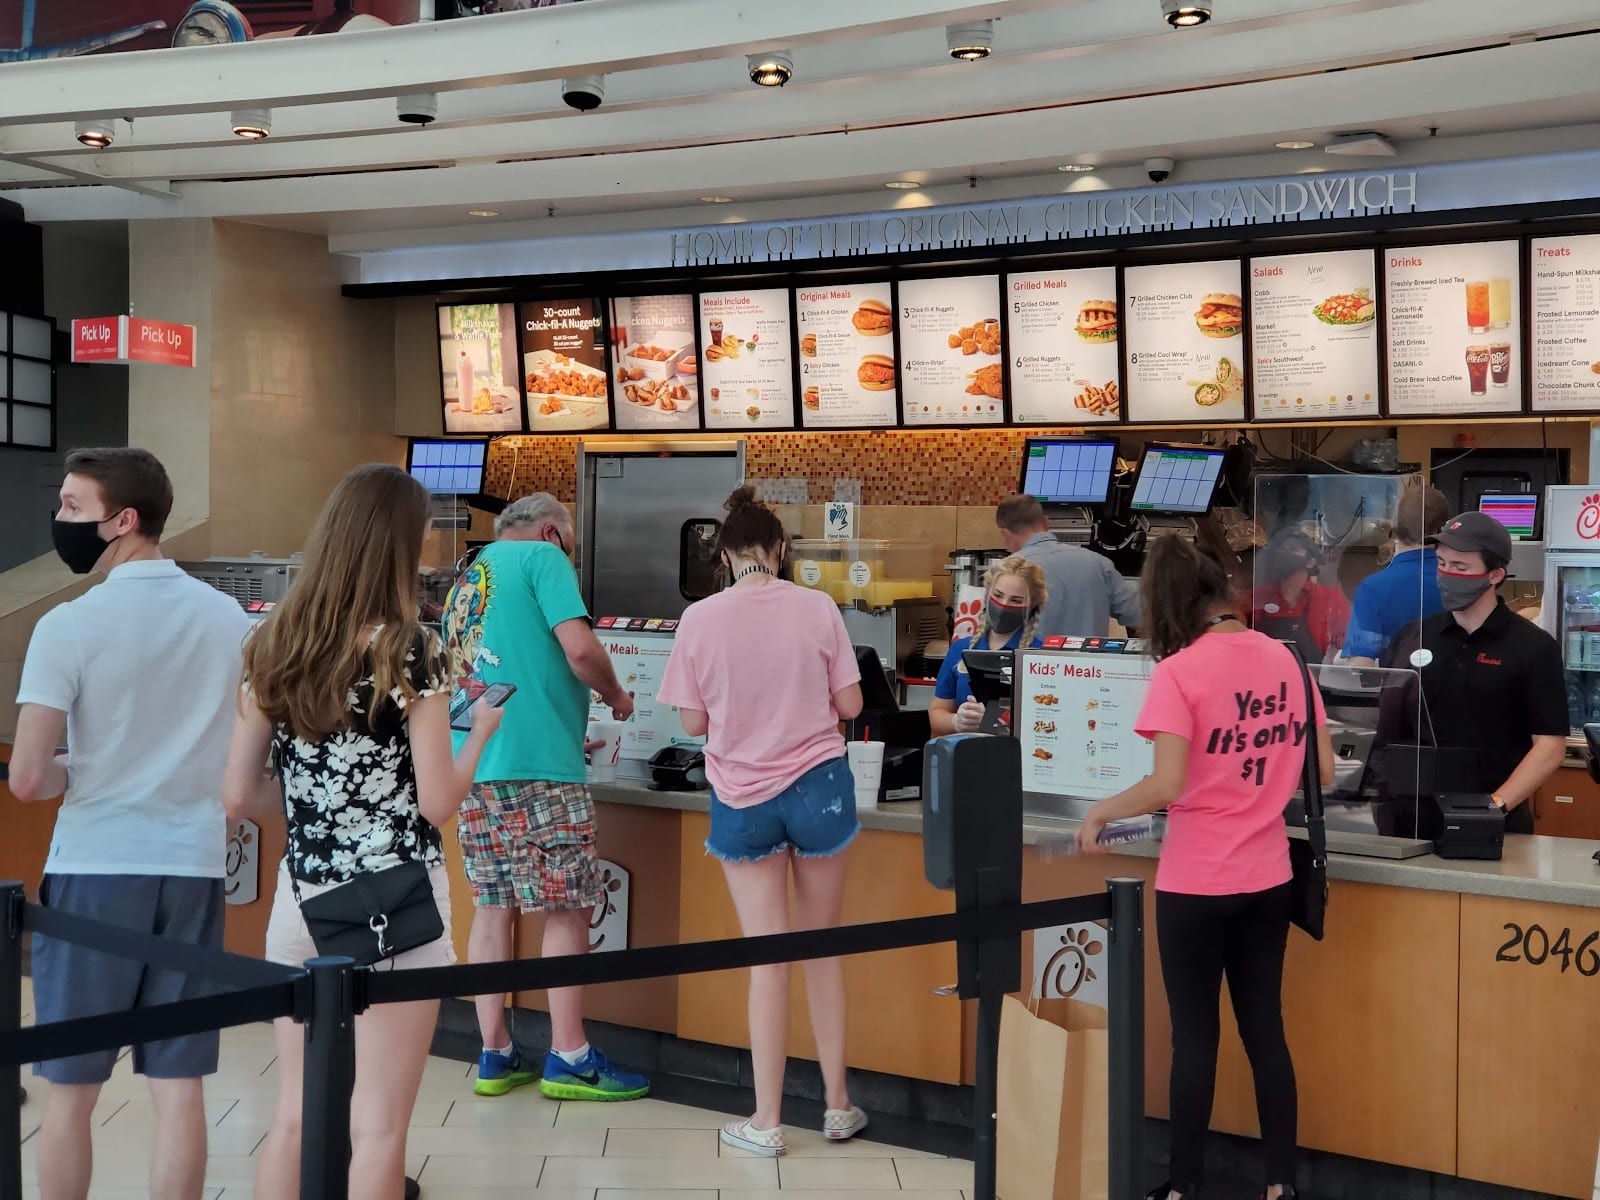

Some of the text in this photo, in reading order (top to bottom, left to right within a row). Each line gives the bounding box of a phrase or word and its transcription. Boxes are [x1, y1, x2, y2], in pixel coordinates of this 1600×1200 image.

[671, 172, 1418, 261] HOME OF THE ORIGINAL CHICKEN SANDWICH
[1537, 247, 1570, 257] Treats
[1391, 257, 1422, 267] Drinks
[1254, 268, 1283, 277] Salads
[1014, 280, 1067, 291] Grilled Meals
[1391, 279, 1437, 287] Freshly-Brewed
[704, 297, 750, 306] Meals Include
[801, 291, 851, 302] Original Meals
[1130, 297, 1136, 308] 7
[544, 307, 581, 317] 30-count
[904, 308, 910, 318] 3
[1014, 303, 1020, 313] 5
[652, 315, 686, 327] Nuggets
[801, 312, 806, 321] 1
[526, 317, 601, 331] Chick-fil-A Nuggets
[81, 324, 111, 343] Pick Up
[141, 326, 182, 349] Pick Up
[1016, 357, 1022, 367] 6
[1131, 353, 1137, 363] 8
[1257, 357, 1272, 365] Spicy
[804, 364, 809, 373] 2
[906, 361, 911, 371] 4
[610, 643, 639, 655] Meals
[1030, 662, 1102, 678] Kids' Meals
[1235, 682, 1287, 720] Yes!
[1207, 713, 1307, 754] It's only
[1240, 757, 1267, 786] $1
[1496, 922, 1600, 977] 2046
